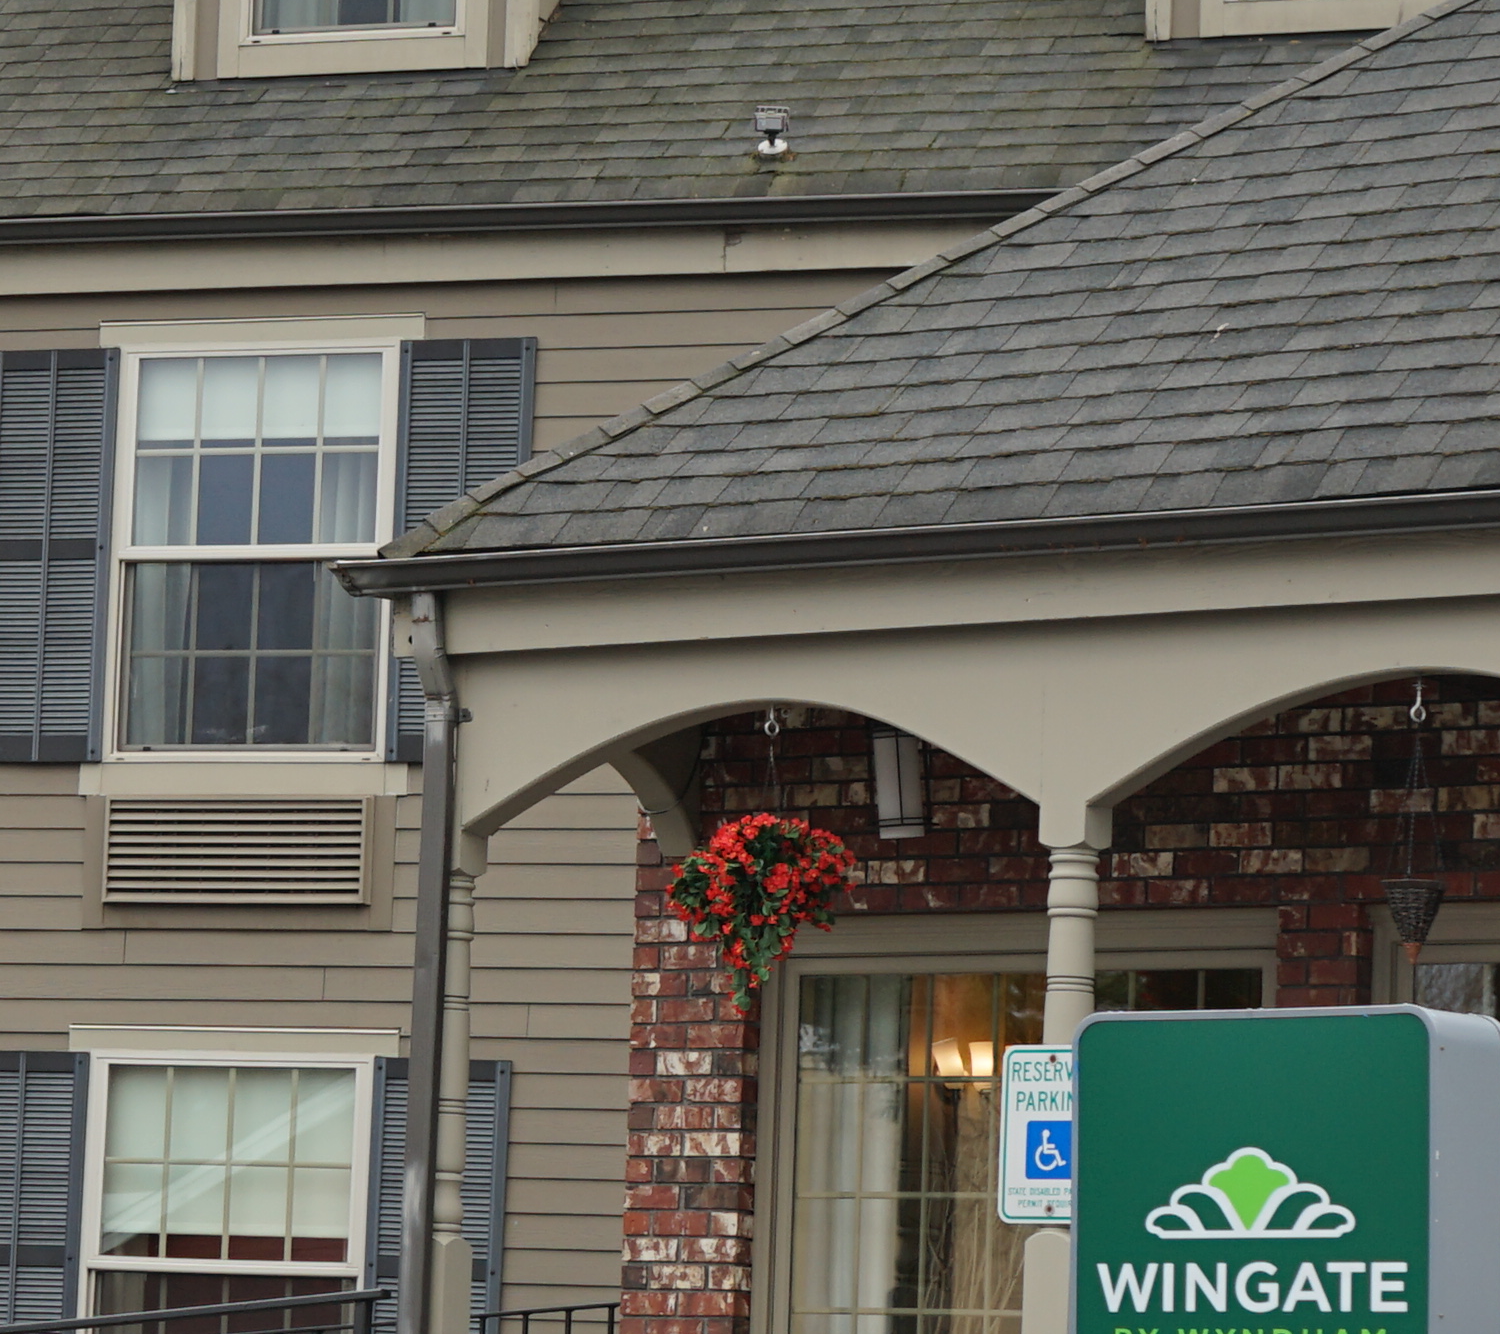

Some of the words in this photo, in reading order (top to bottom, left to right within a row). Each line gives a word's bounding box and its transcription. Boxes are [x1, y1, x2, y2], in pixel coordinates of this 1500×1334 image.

[1012, 1061, 1073, 1082] RESERV
[1016, 1090, 1073, 1111] PARKIN
[1030, 1187, 1061, 1196] DISABLED
[1096, 1261, 1409, 1315] WINGATE
